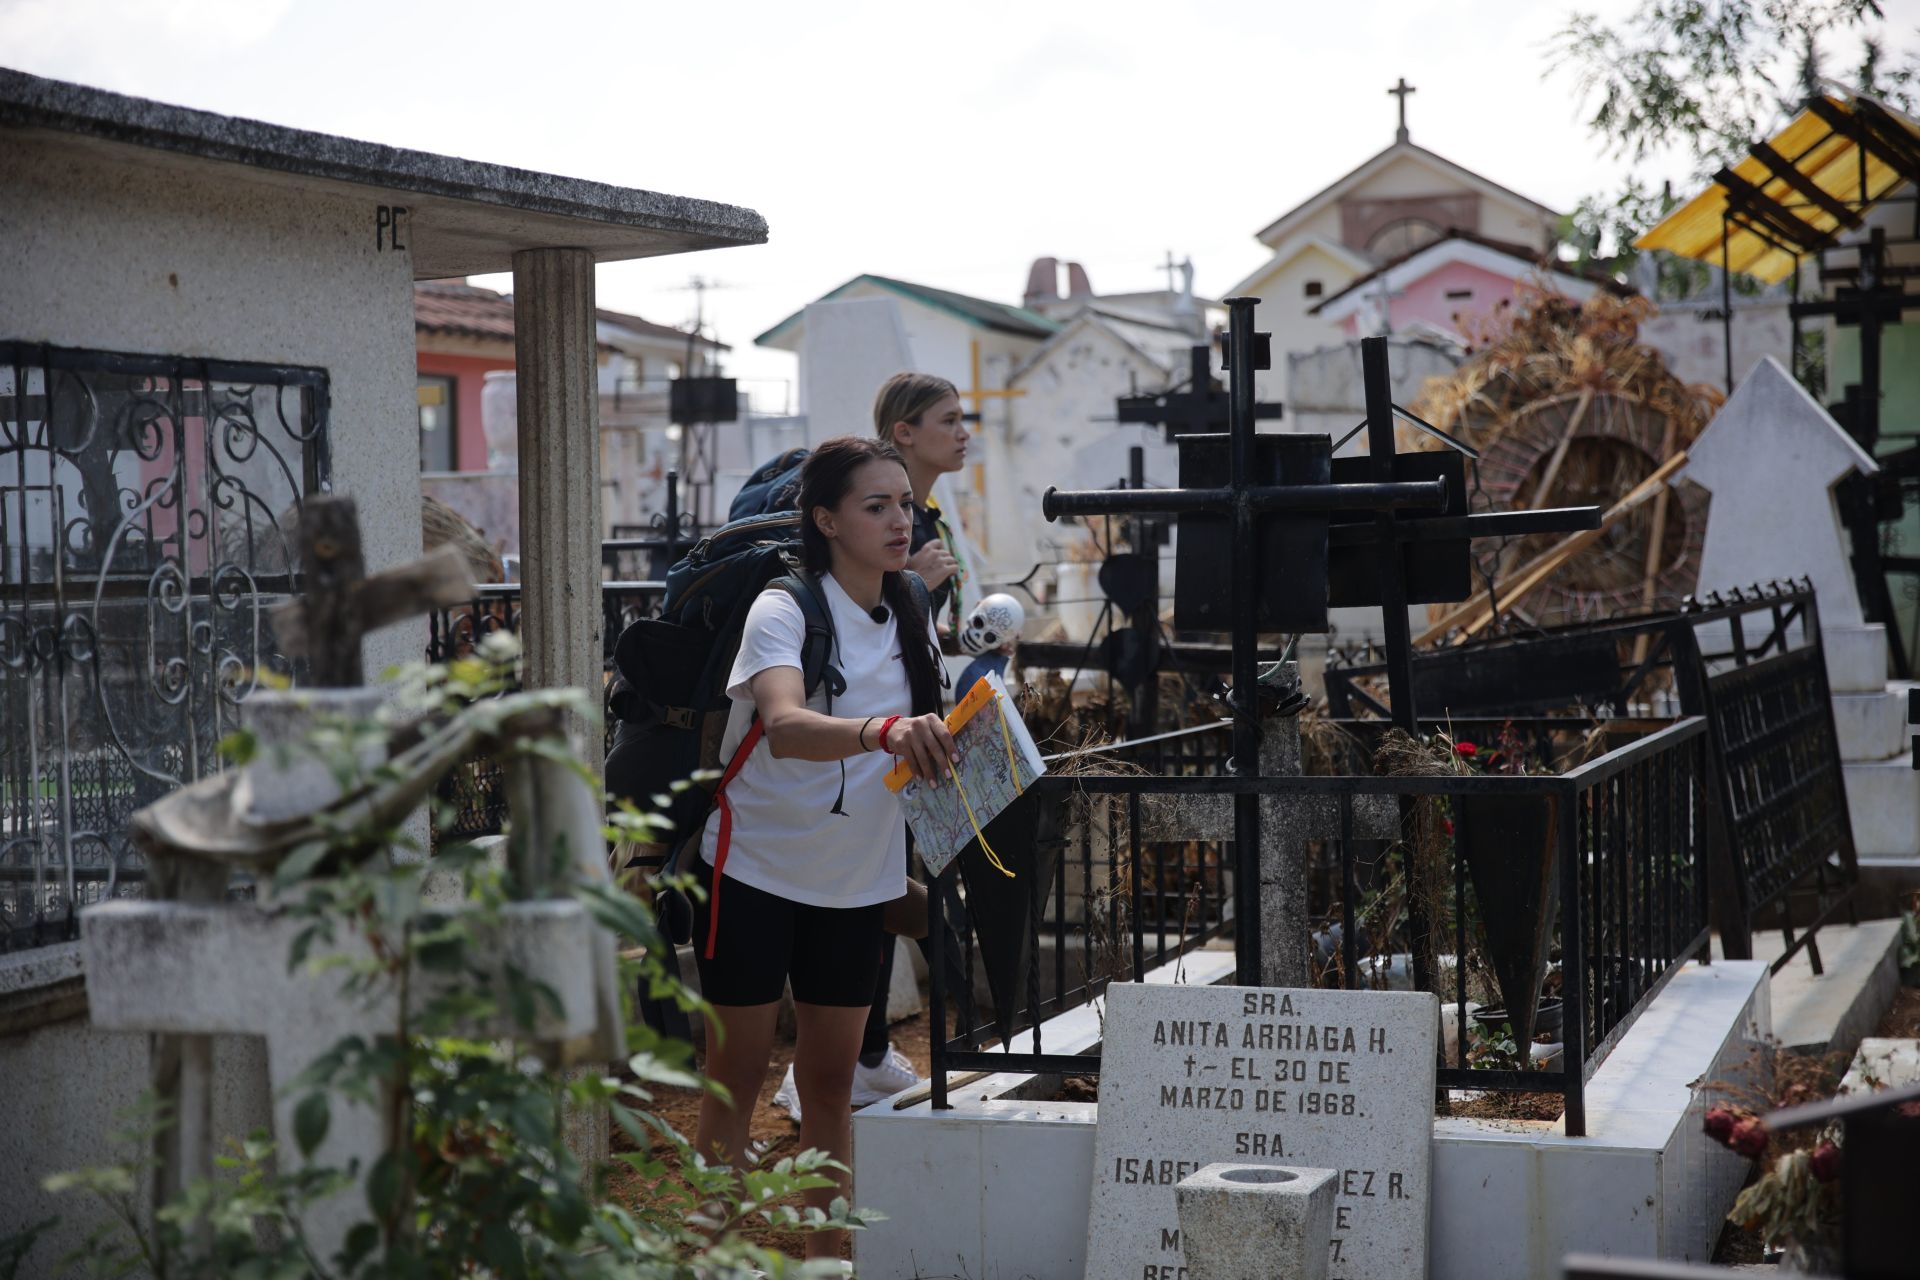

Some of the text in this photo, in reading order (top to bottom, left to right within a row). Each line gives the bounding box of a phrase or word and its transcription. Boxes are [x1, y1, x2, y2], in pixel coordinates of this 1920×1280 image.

[1243, 992, 1302, 1017] SRA.
[1153, 1020, 1394, 1054] ANITA ARRIAGA H.
[1231, 1057, 1262, 1081] EL
[1274, 1059, 1307, 1083] 30
[1318, 1060, 1351, 1085] DE
[1160, 1085, 1365, 1118] MARZO DE 1968.
[1235, 1132, 1294, 1158] SRA.
[1388, 1172, 1410, 1200] R.
